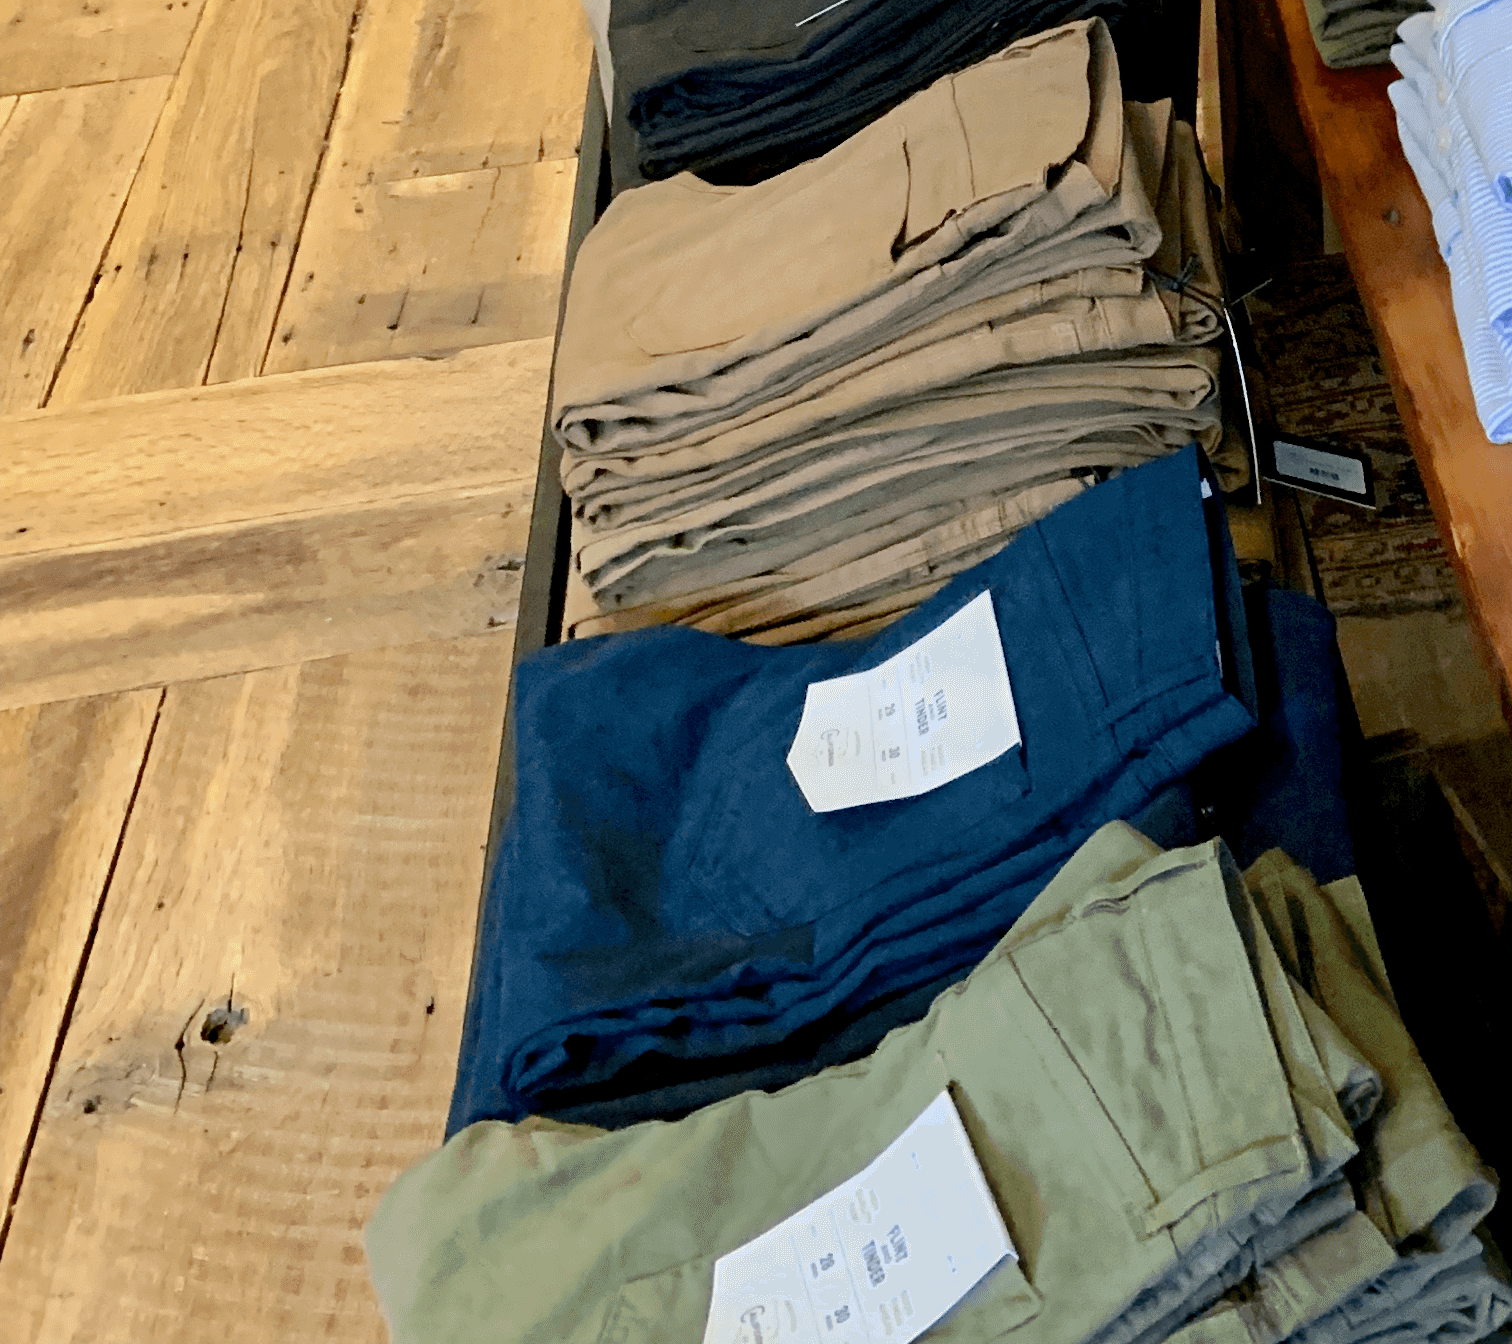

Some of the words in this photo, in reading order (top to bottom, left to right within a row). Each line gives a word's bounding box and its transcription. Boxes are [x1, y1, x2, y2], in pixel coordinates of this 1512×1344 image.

[914, 697, 930, 737] TINDER
[934, 688, 948, 721] FLINT
[887, 1223, 909, 1263] FLINT
[862, 1239, 886, 1288] TINDER
